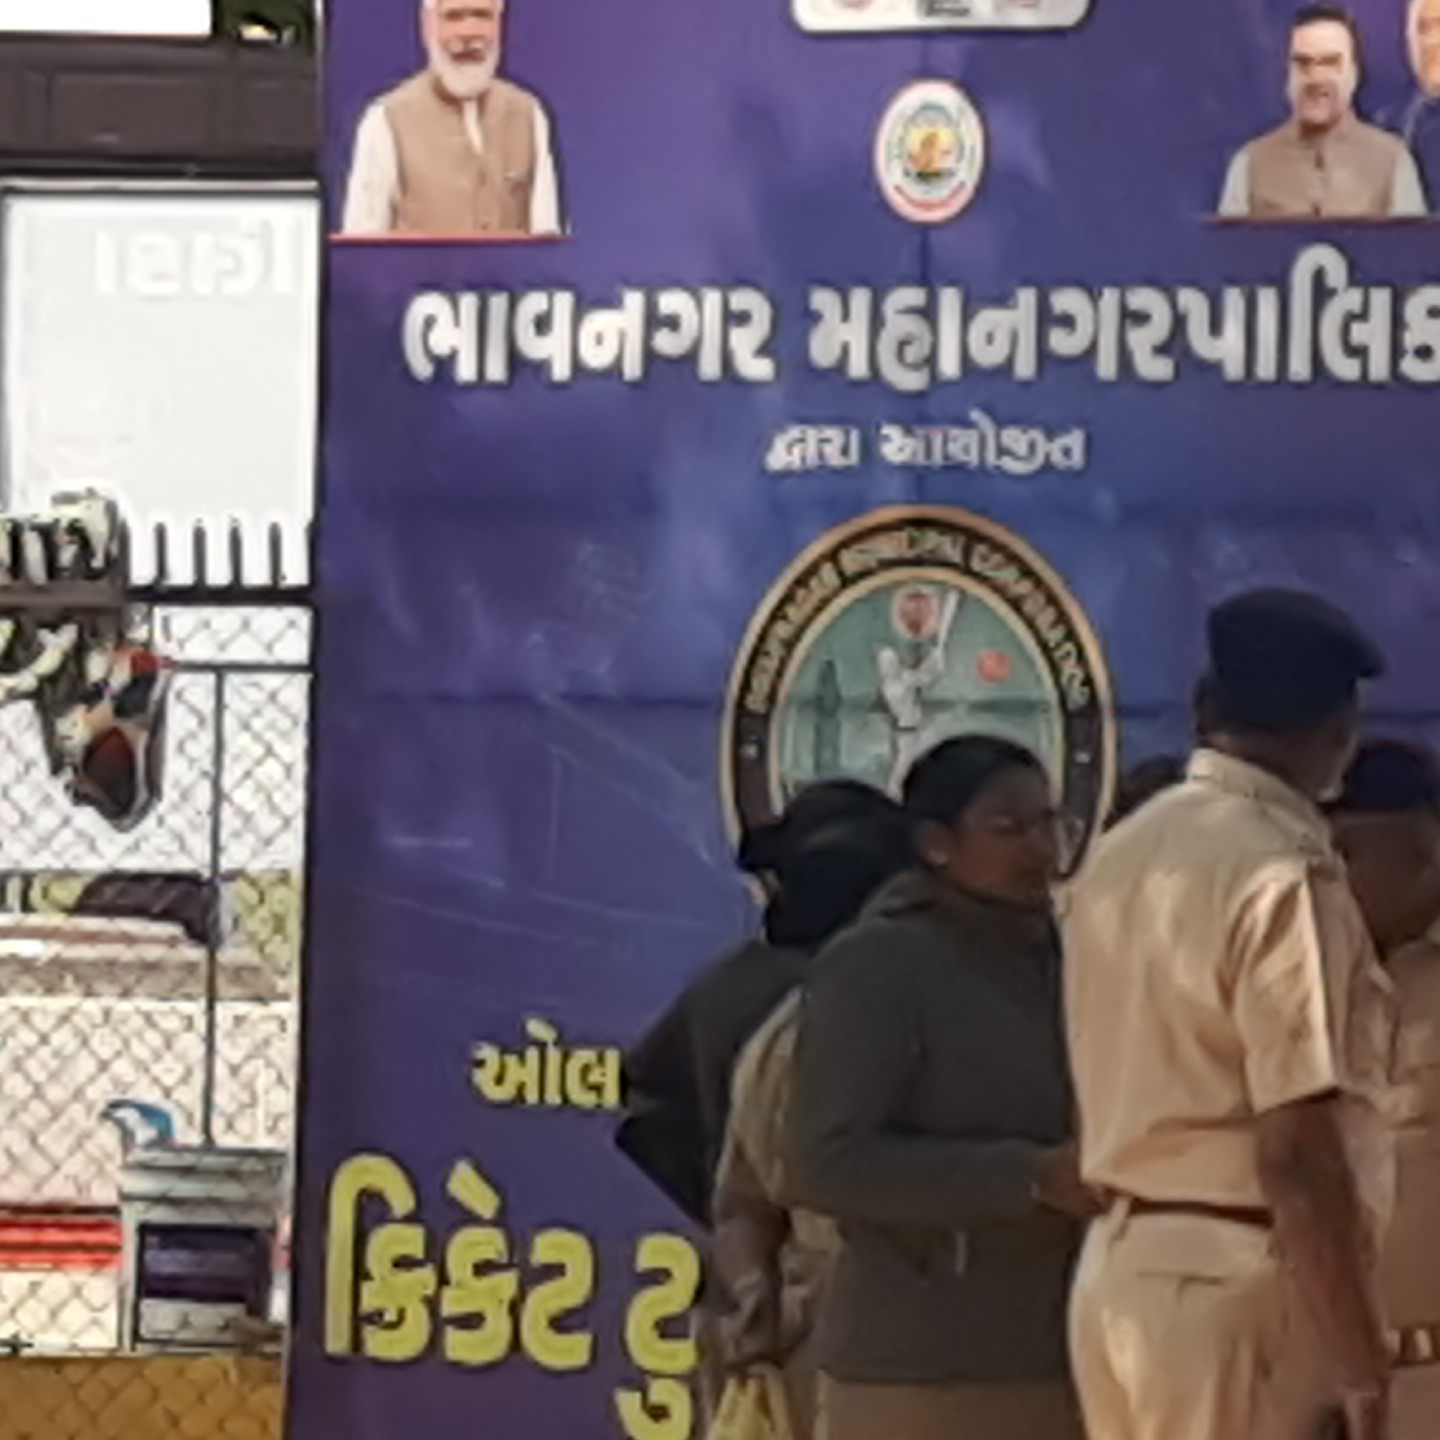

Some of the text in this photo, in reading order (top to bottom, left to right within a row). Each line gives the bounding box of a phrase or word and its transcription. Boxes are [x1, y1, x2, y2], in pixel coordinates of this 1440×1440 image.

[404, 287, 775, 382] ભાવનગર
[472, 1018, 620, 1109] ઓલ
[324, 1153, 594, 1371] ક્રિકેટ
